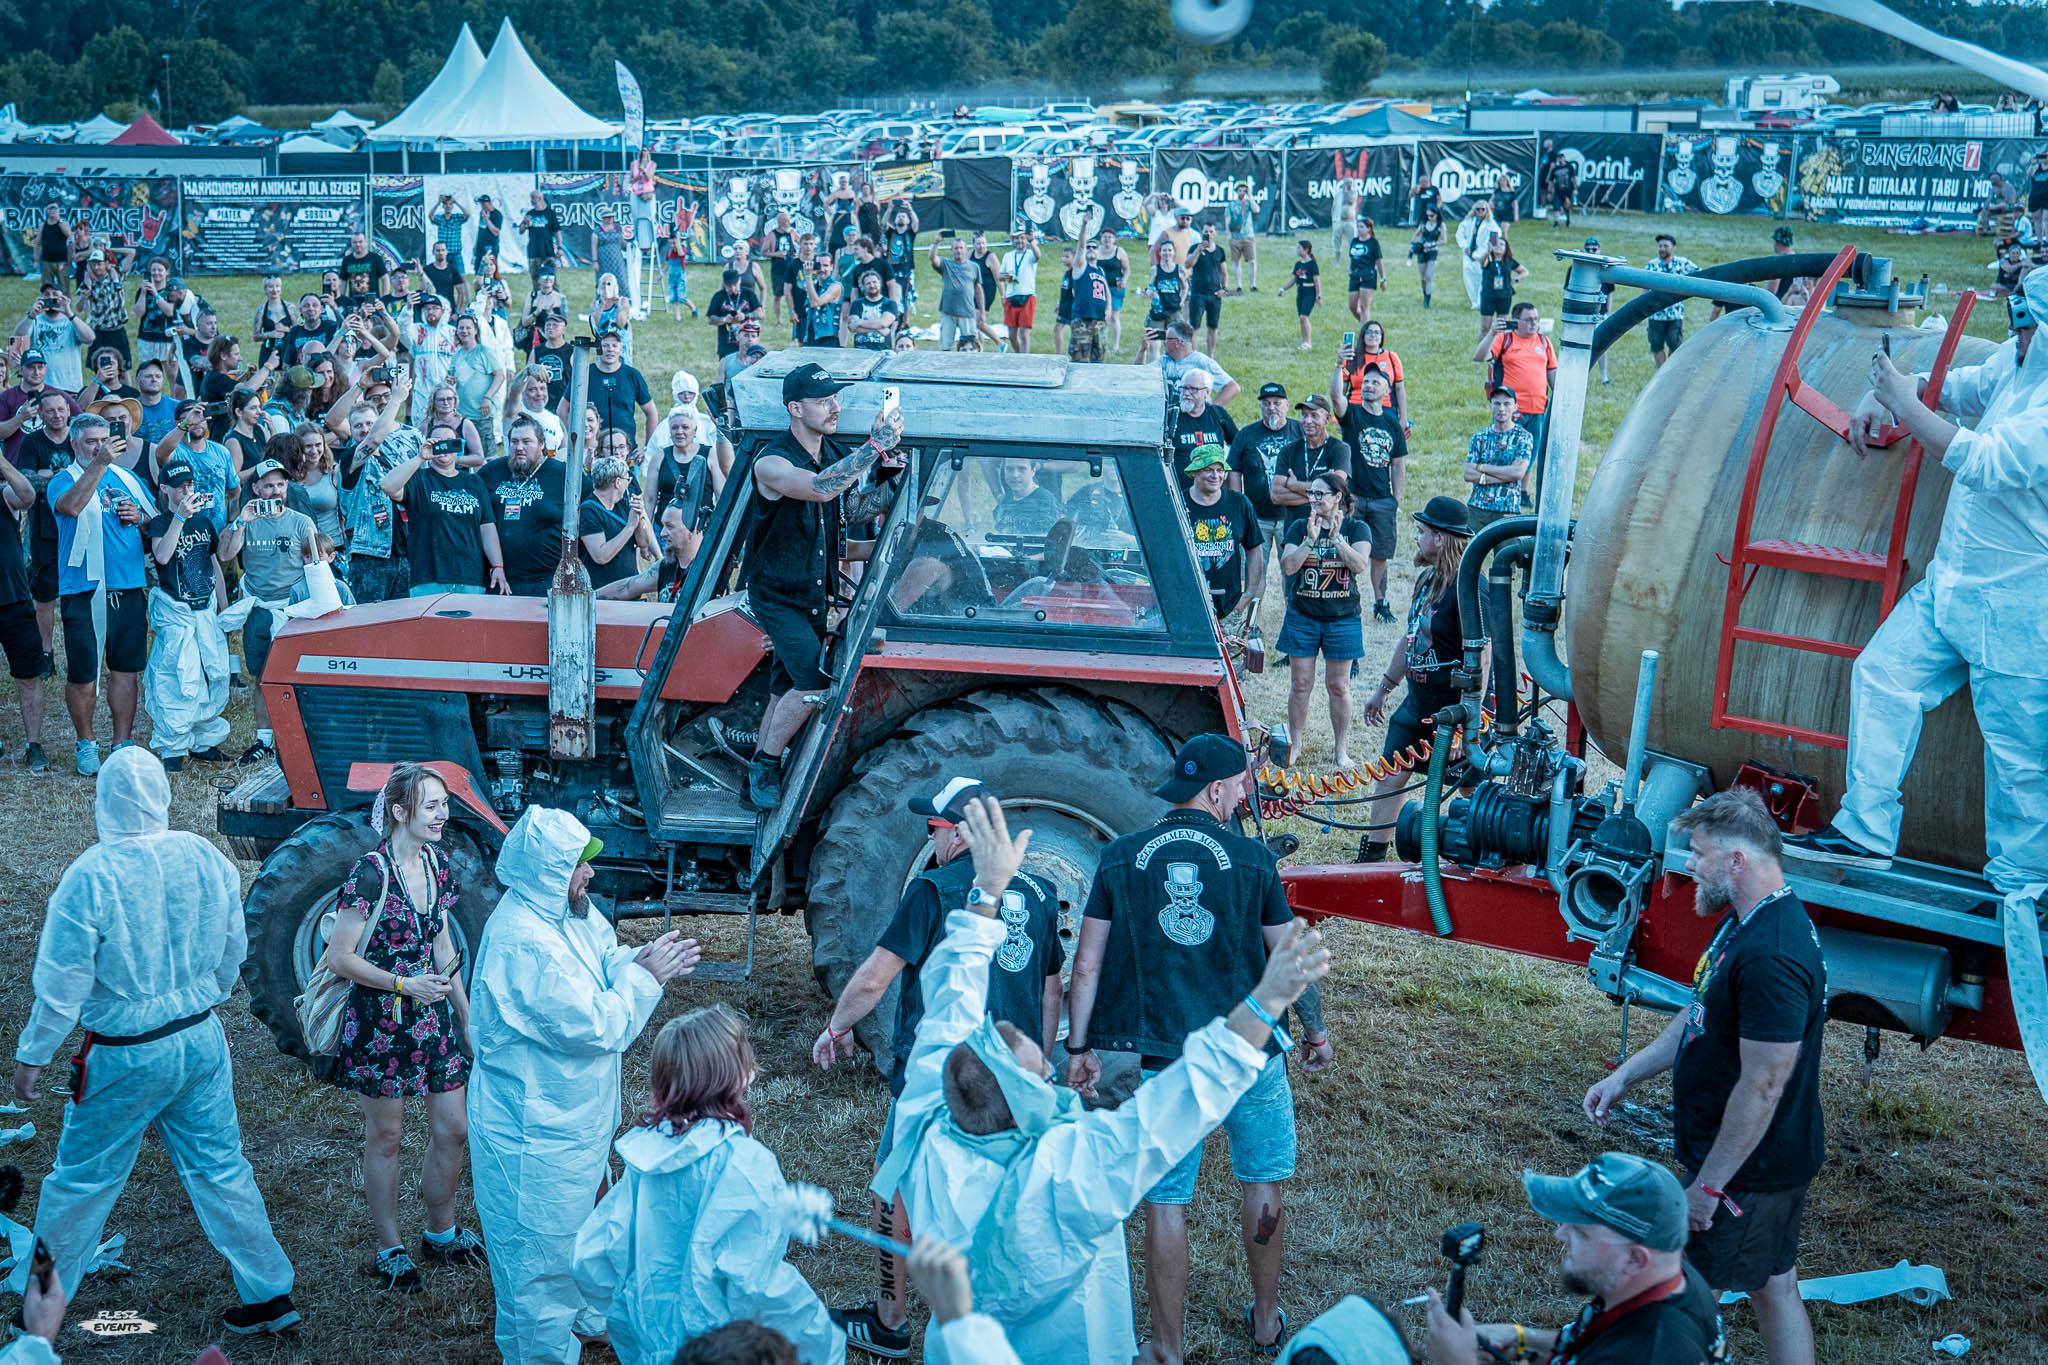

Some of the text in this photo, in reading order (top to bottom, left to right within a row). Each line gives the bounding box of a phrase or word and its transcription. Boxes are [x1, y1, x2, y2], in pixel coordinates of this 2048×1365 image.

[1863, 143, 1967, 172] BANGARANG
[184, 180, 362, 196] HARMONOGRAM ANIMACJI DLA DZIECI
[1308, 176, 1393, 199] BANGRANG
[1826, 176, 1855, 194] HATE
[1868, 176, 1917, 196] GUTALAX
[1932, 178, 1960, 197] TABU
[4, 208, 141, 234] BANARANG
[439, 502, 474, 514] TEAM
[1322, 590, 1351, 599] EDITION
[328, 660, 358, 671] 914
[503, 666, 612, 683] URS
[878, 1201, 897, 1302] BANARANG
